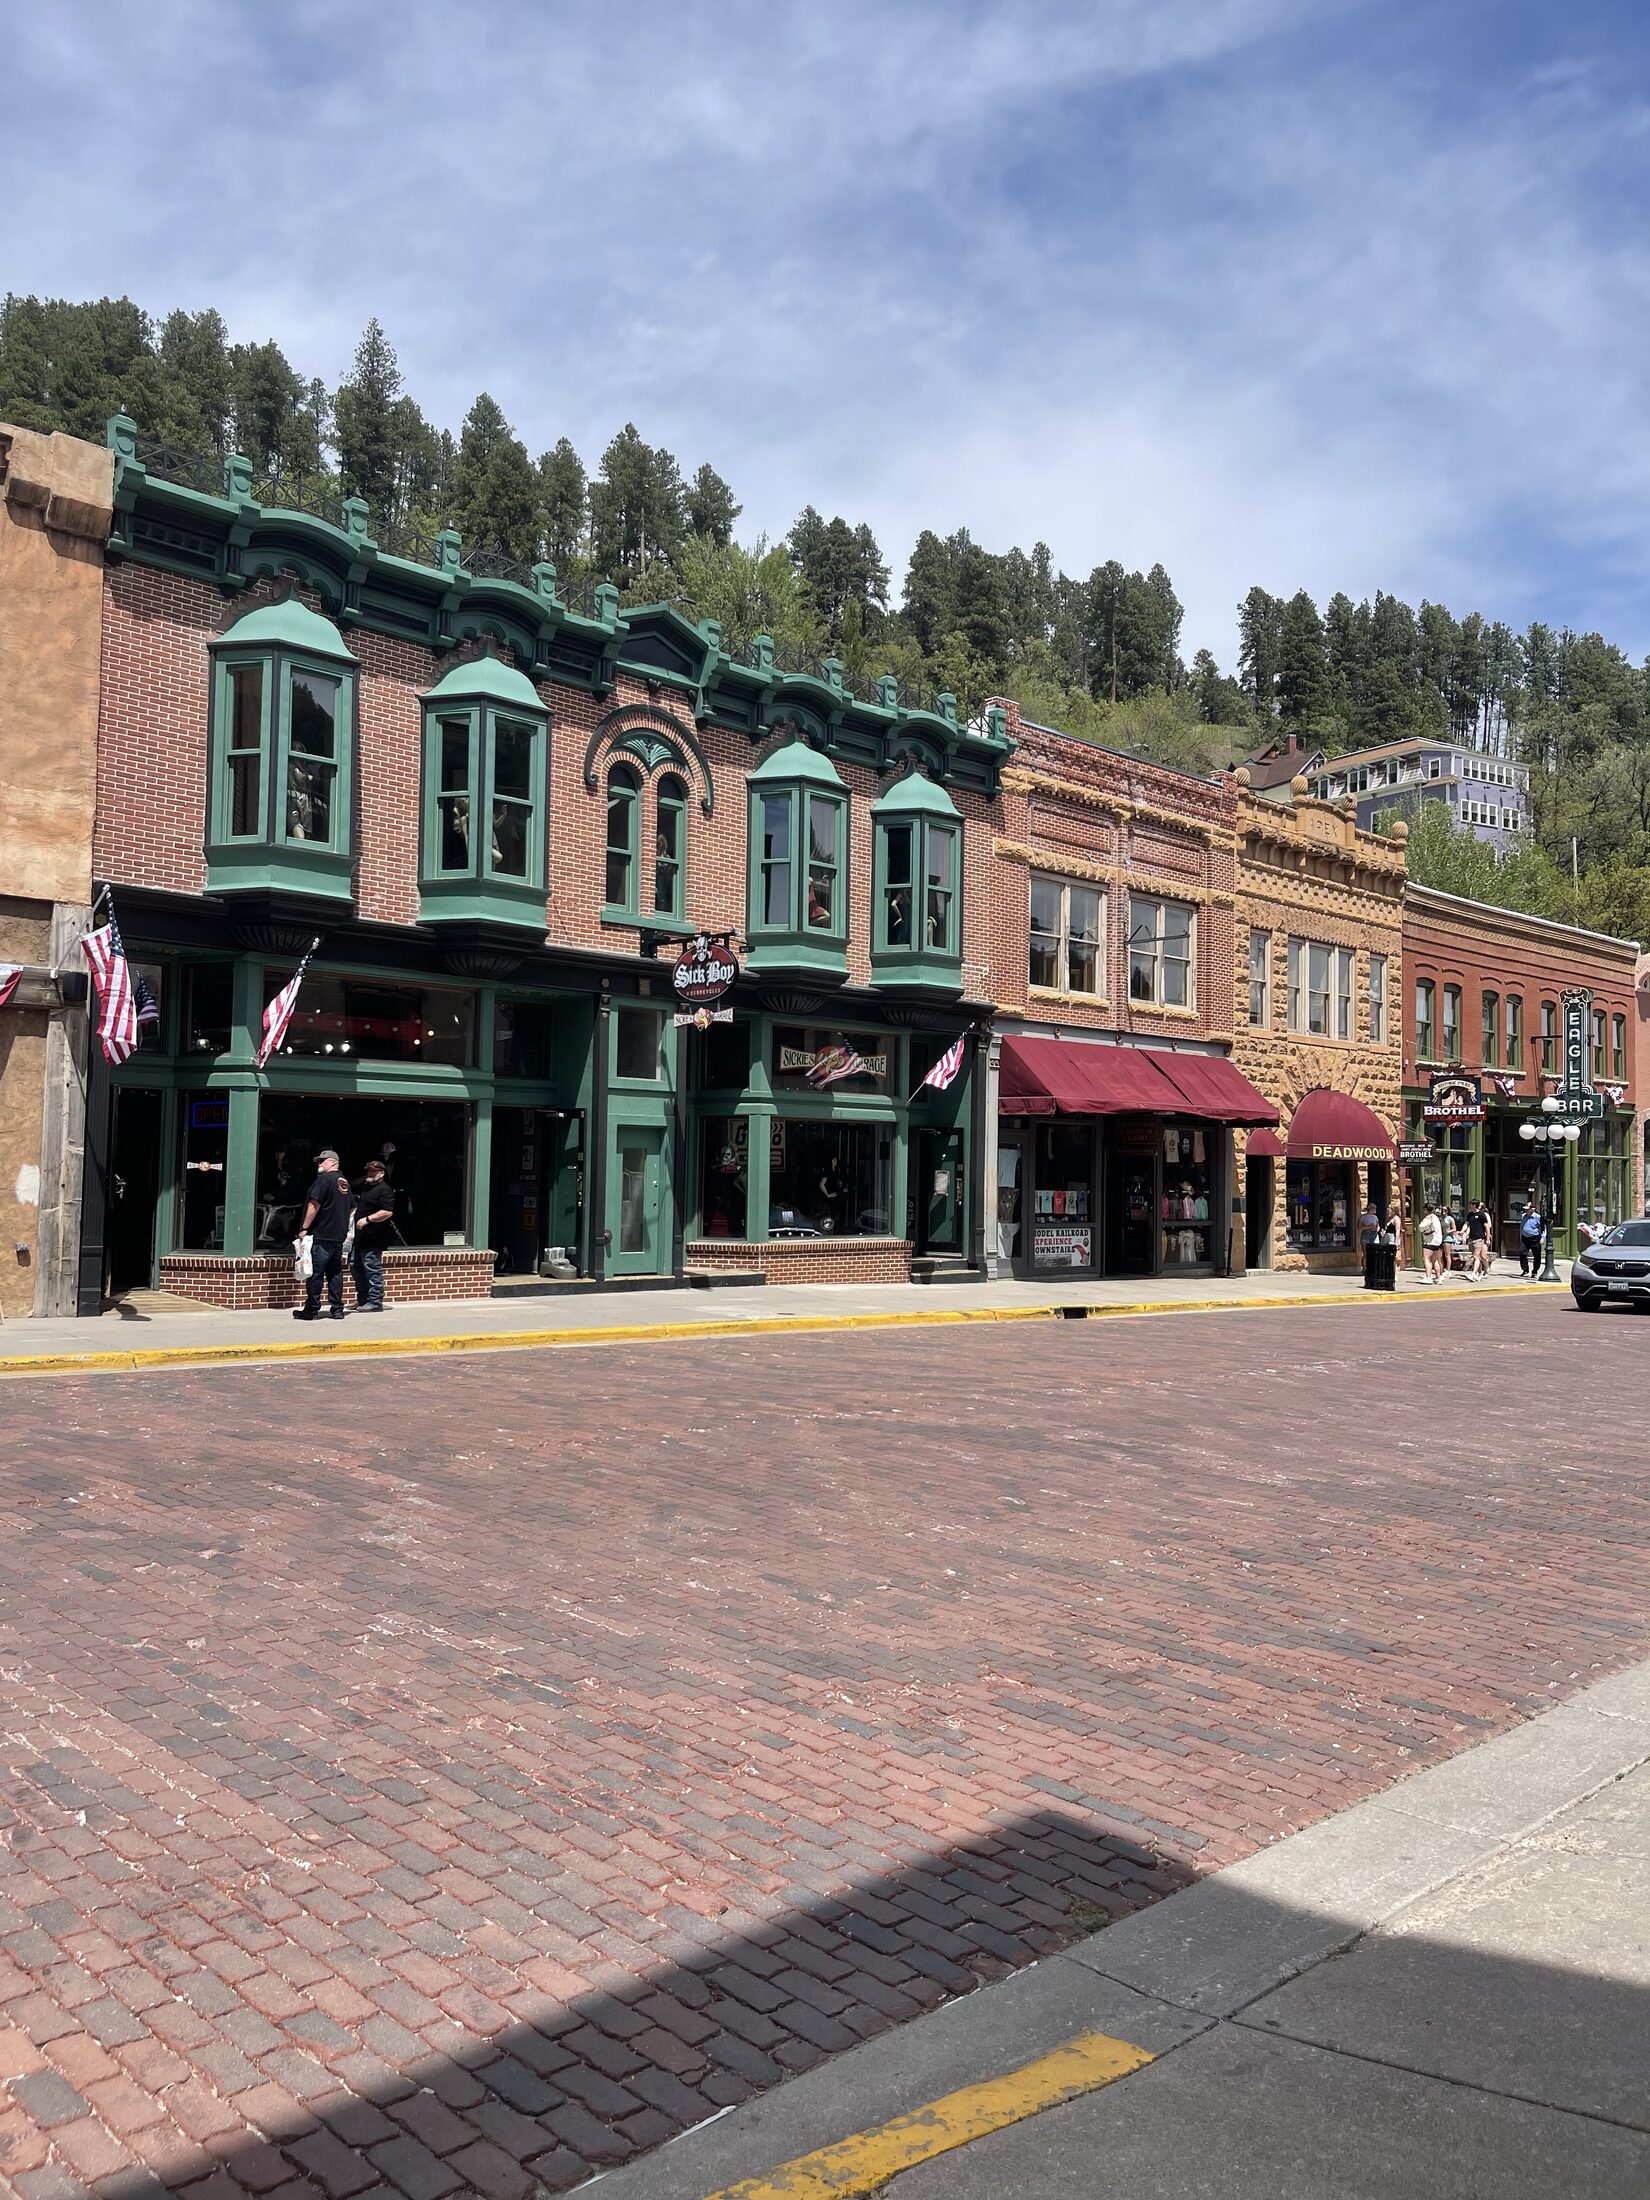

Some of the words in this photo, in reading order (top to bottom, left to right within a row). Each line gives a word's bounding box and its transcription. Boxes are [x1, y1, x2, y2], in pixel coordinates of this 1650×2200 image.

[674, 963, 705, 988] Sick
[706, 960, 735, 987] Boy
[784, 1049, 815, 1066] SICKIES
[1568, 1012, 1581, 1090] EAGLE
[1423, 1105, 1485, 1116] BROTHEL
[1557, 1099, 1595, 1112] BAR
[1312, 1146, 1385, 1159] DEADWOOD
[1035, 1229, 1054, 1237] ODEL
[1056, 1229, 1089, 1237] RAILROAD
